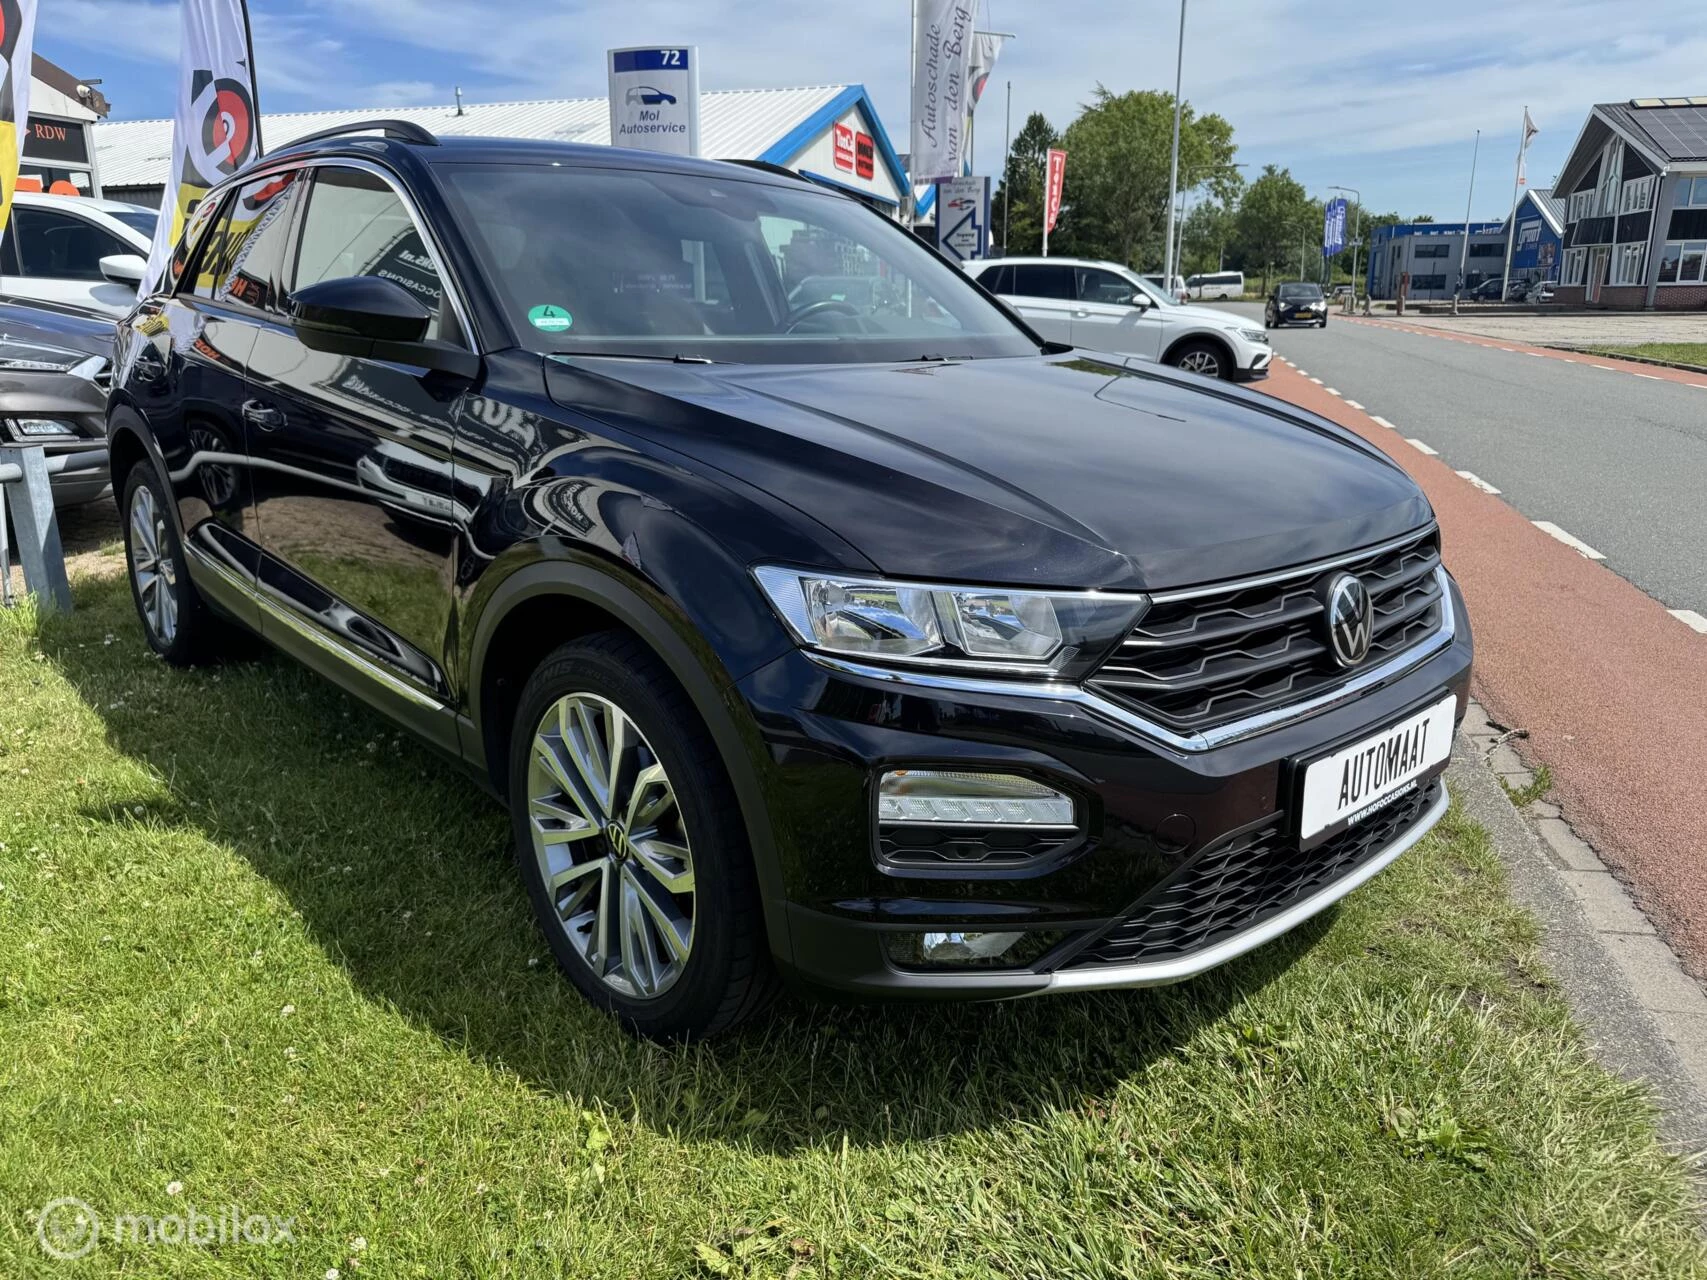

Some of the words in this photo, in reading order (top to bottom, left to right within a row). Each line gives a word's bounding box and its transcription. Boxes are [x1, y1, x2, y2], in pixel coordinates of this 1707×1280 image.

[942, 6, 972, 59] Berg
[660, 50, 681, 65] 72
[921, 23, 941, 148] Autoschade
[943, 71, 960, 111] den
[619, 122, 686, 135] Autoservice
[639, 110, 660, 121] Mol
[35, 123, 66, 141] RDW
[948, 127, 958, 161] van
[543, 305, 556, 318] 4
[1337, 718, 1431, 810] AUTOMAAT
